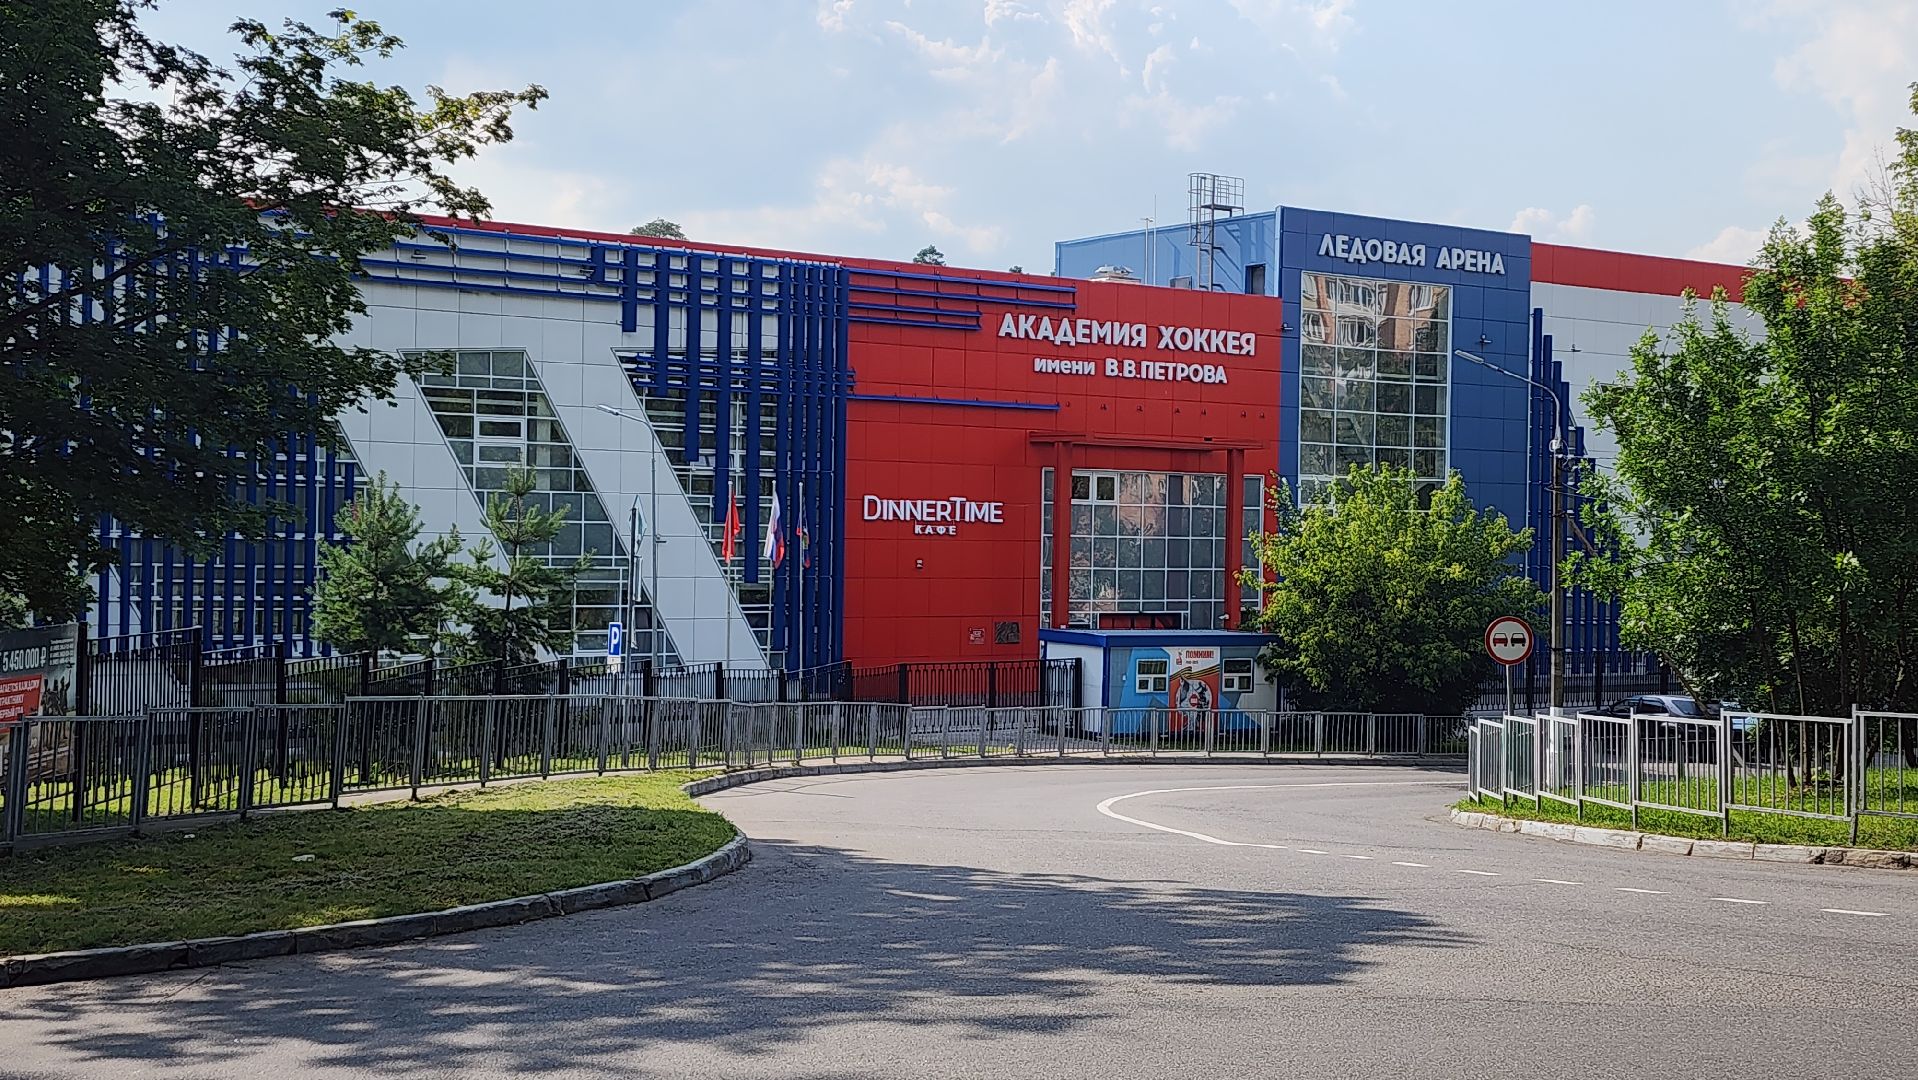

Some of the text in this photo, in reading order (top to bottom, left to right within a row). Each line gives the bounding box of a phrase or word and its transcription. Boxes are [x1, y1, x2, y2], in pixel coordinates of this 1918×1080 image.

[1318, 233, 1506, 275] ЛЕДОВАЯ АРЕНА
[998, 313, 1256, 356] АКАДЕМИЯ ХОККЕЯ
[1034, 358, 1228, 384] имени В.В.ПЕТРОВА
[914, 524, 957, 535] КАФЕ
[610, 626, 620, 654] P
